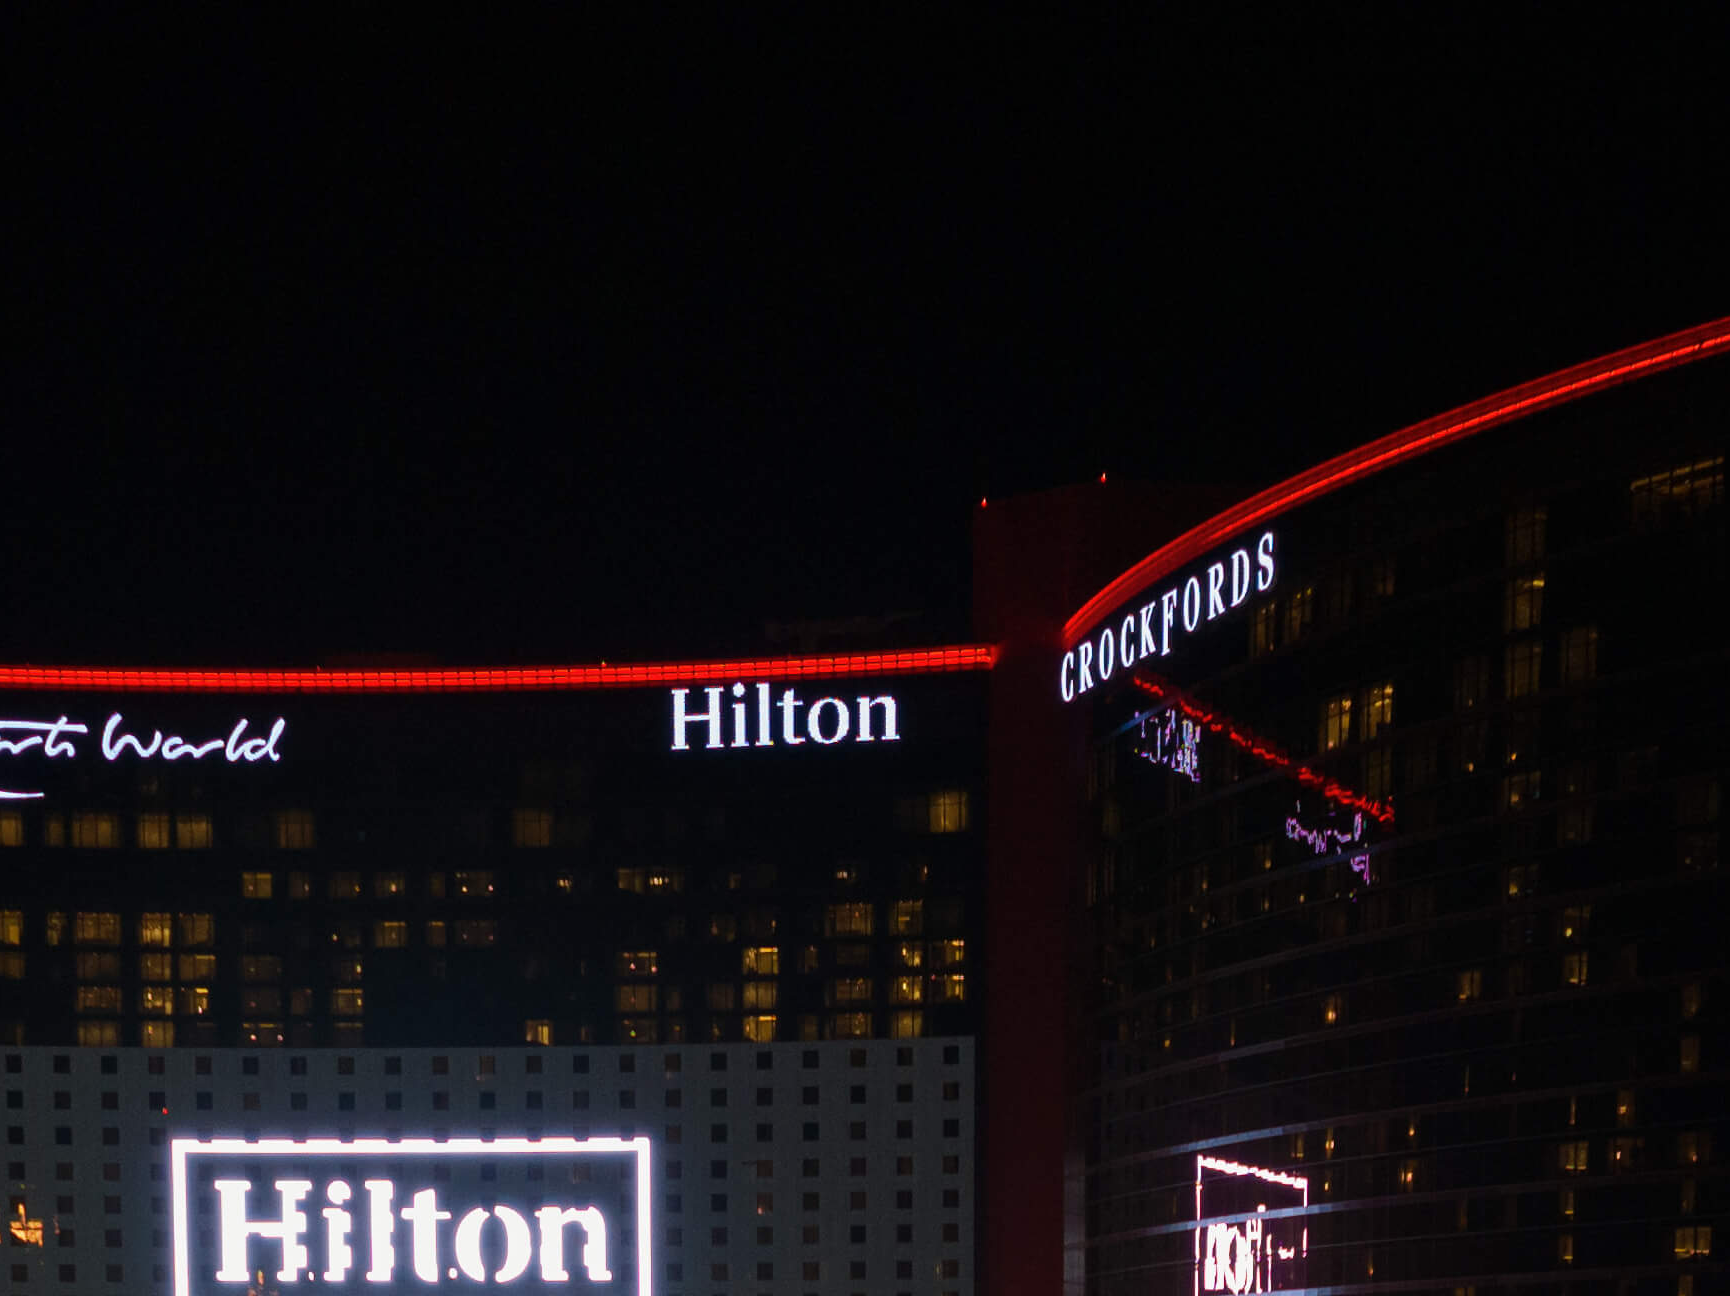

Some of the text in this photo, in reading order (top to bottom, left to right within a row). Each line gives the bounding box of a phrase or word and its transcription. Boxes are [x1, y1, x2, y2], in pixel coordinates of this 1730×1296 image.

[1060, 531, 1275, 703] CROCKFORDS
[101, 713, 286, 762] World
[671, 682, 902, 751] Hilton
[213, 1178, 613, 1284] Hilton
